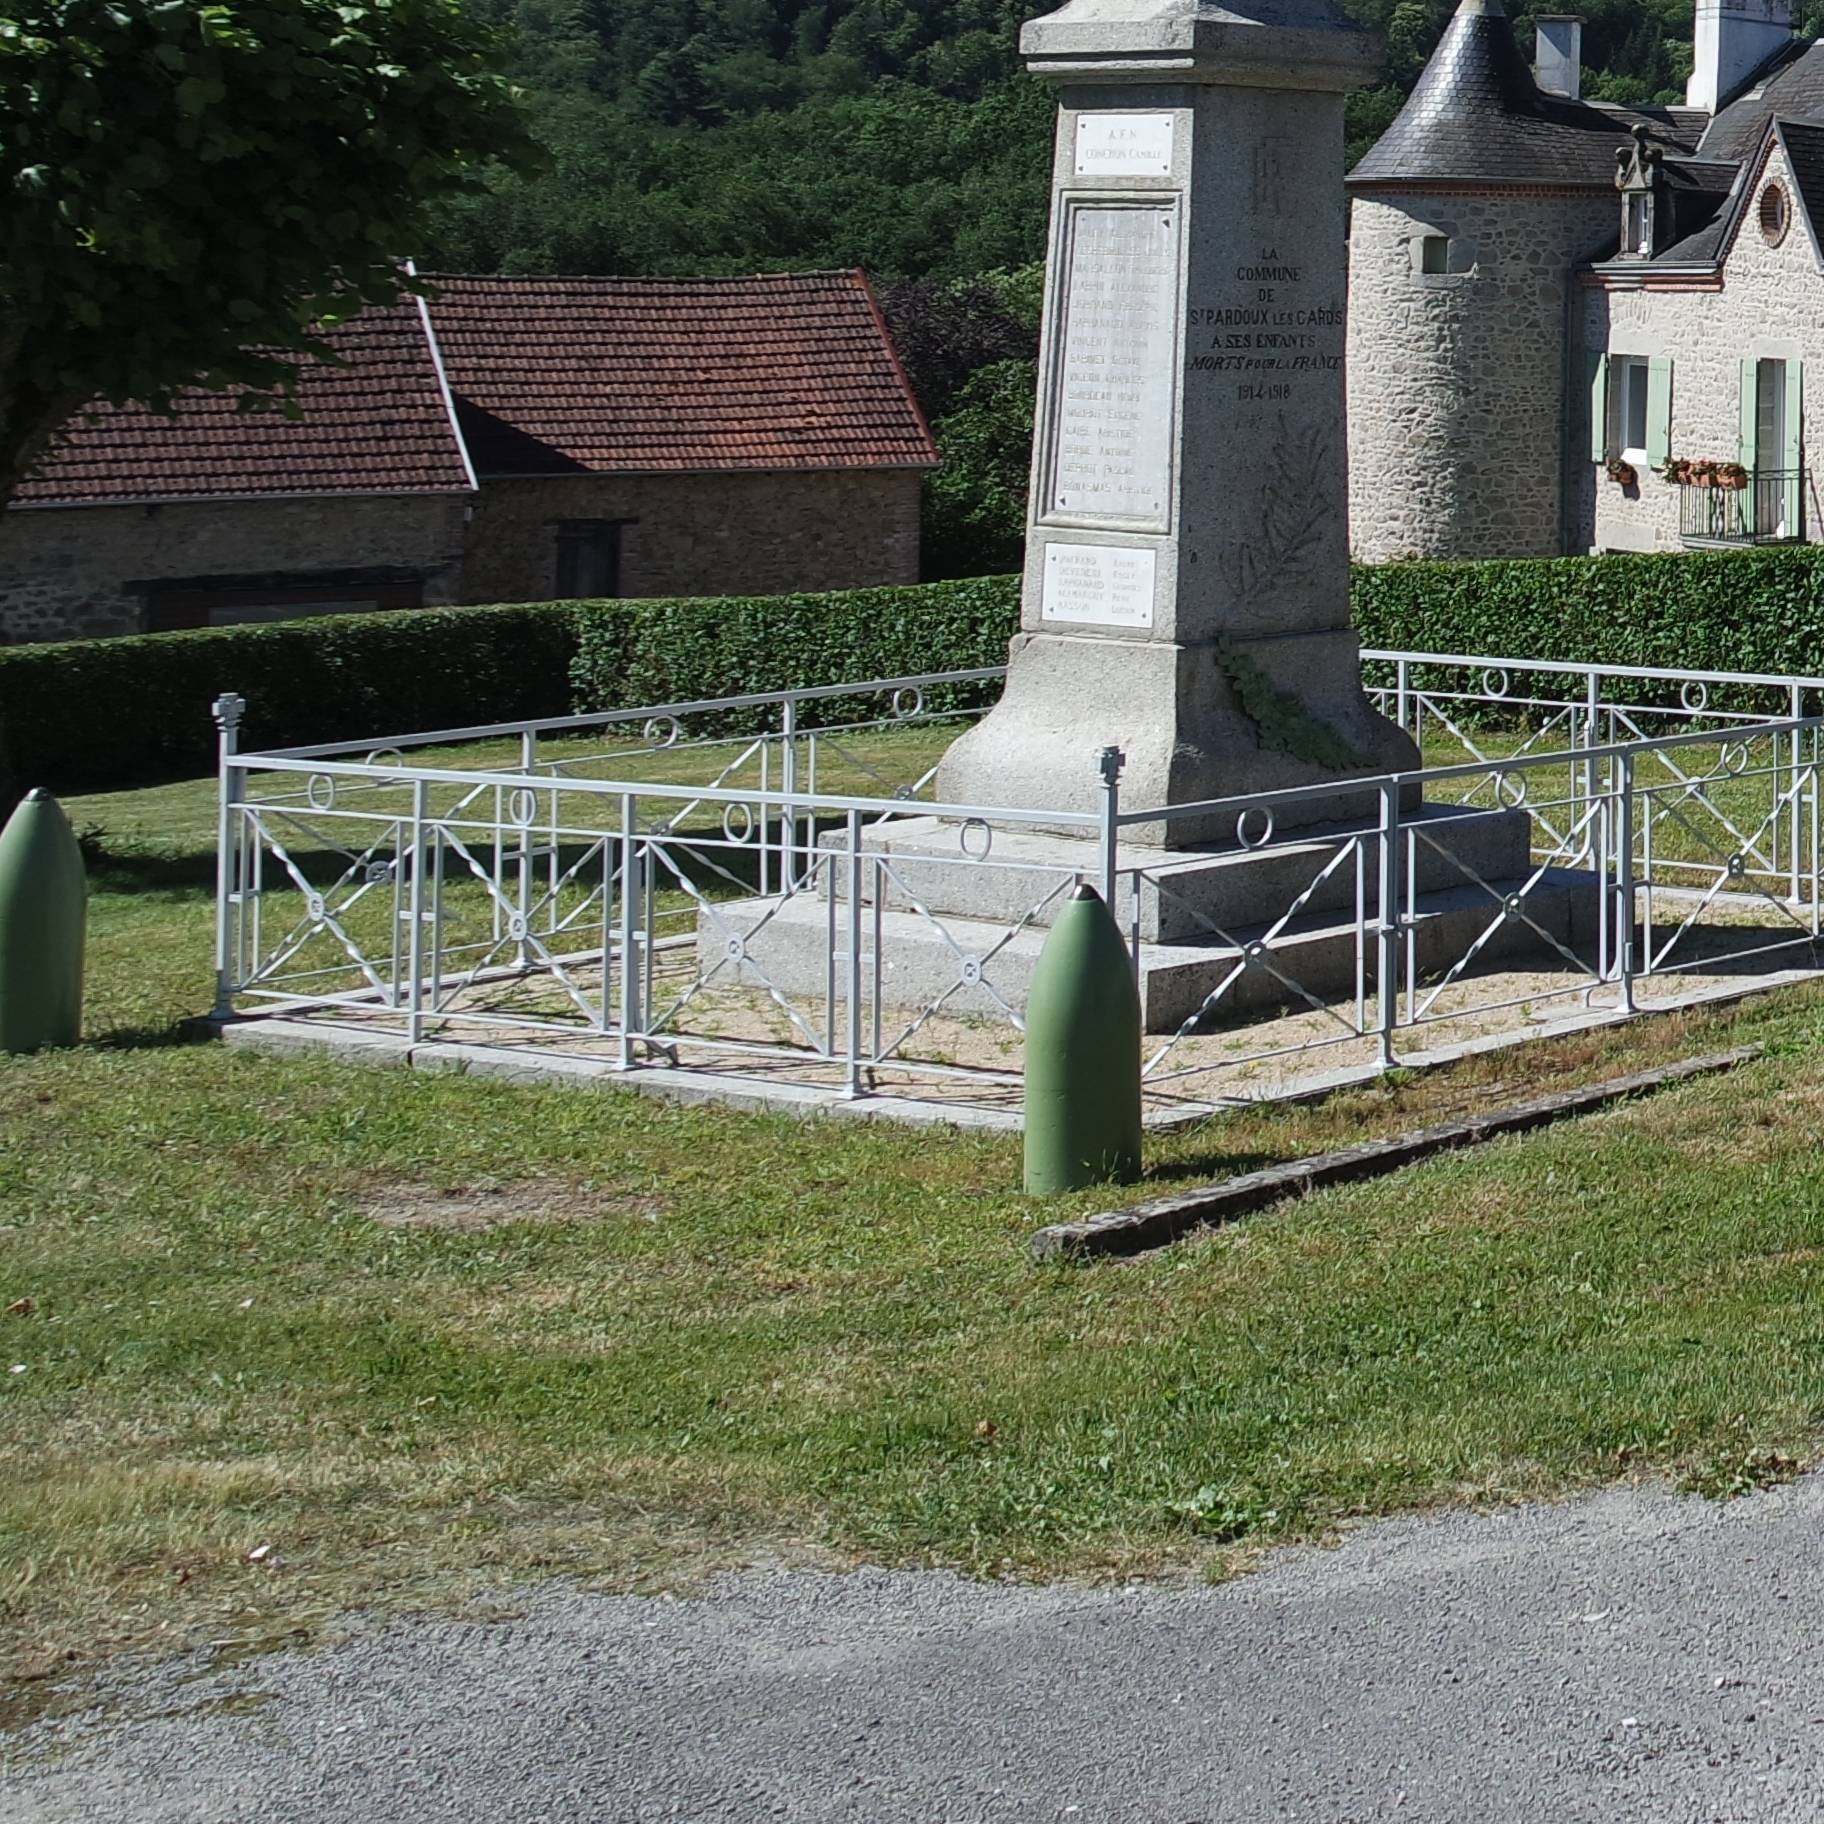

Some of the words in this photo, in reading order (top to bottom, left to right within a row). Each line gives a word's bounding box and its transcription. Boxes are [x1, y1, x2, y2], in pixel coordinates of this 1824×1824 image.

[1261, 248, 1279, 260] LA
[1237, 267, 1301, 281] COMMUNE
[1258, 288, 1275, 302] DE
[1206, 309, 1269, 325] PARDOUX
[1273, 313, 1293, 325] LES
[1296, 309, 1343, 325] CARDS
[1211, 335, 1222, 349] A
[1225, 334, 1250, 349] SES
[1256, 333, 1316, 349] ENFANTS
[1190, 356, 1245, 370] MORTS
[1245, 359, 1277, 370] POUR
[1291, 355, 1342, 370] FRANCE
[1238, 384, 1291, 400] 1914-1918
